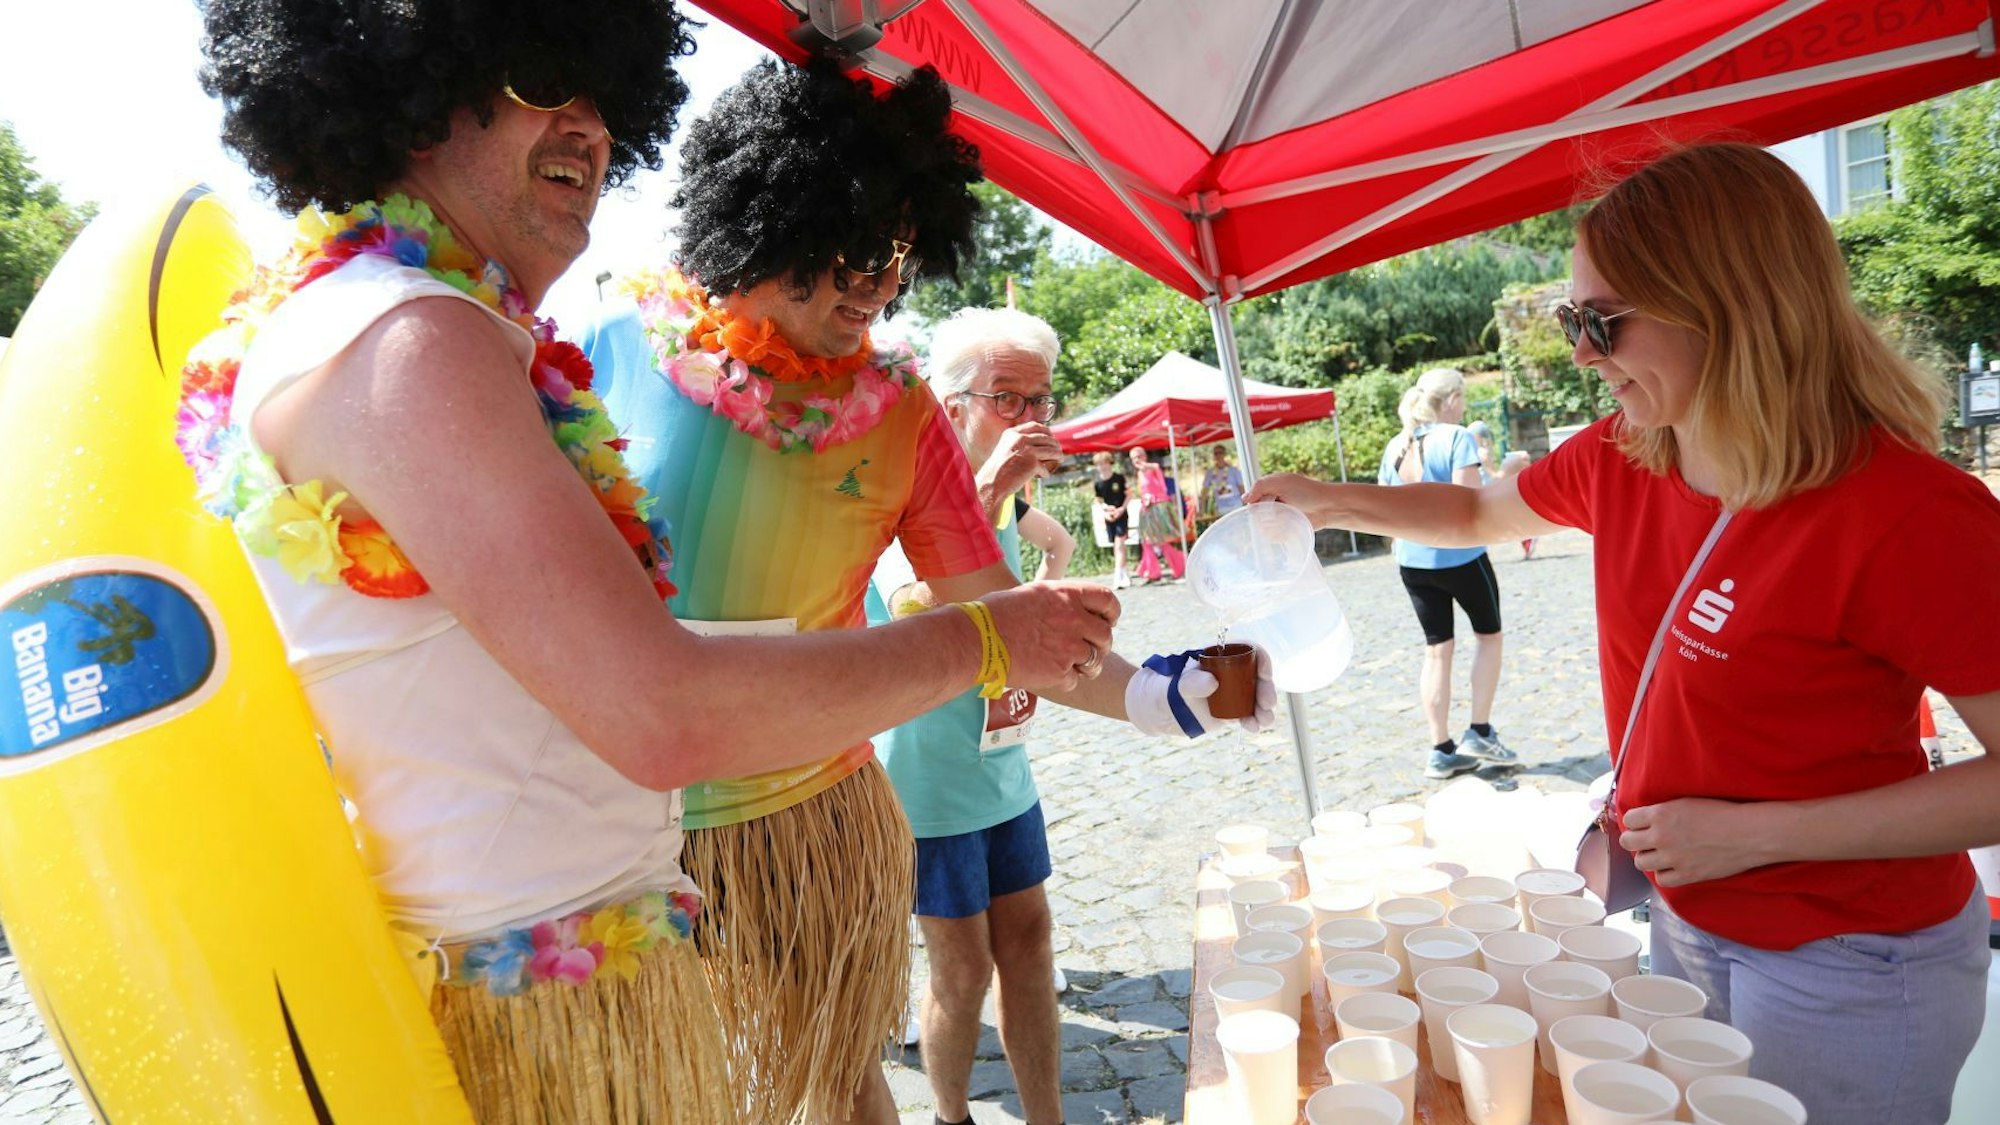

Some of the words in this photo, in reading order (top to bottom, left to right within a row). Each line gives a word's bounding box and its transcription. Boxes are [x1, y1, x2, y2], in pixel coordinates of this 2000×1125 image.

[12, 621, 60, 746] Banana
[1678, 645, 1698, 662] Köln
[59, 663, 108, 724] Big
